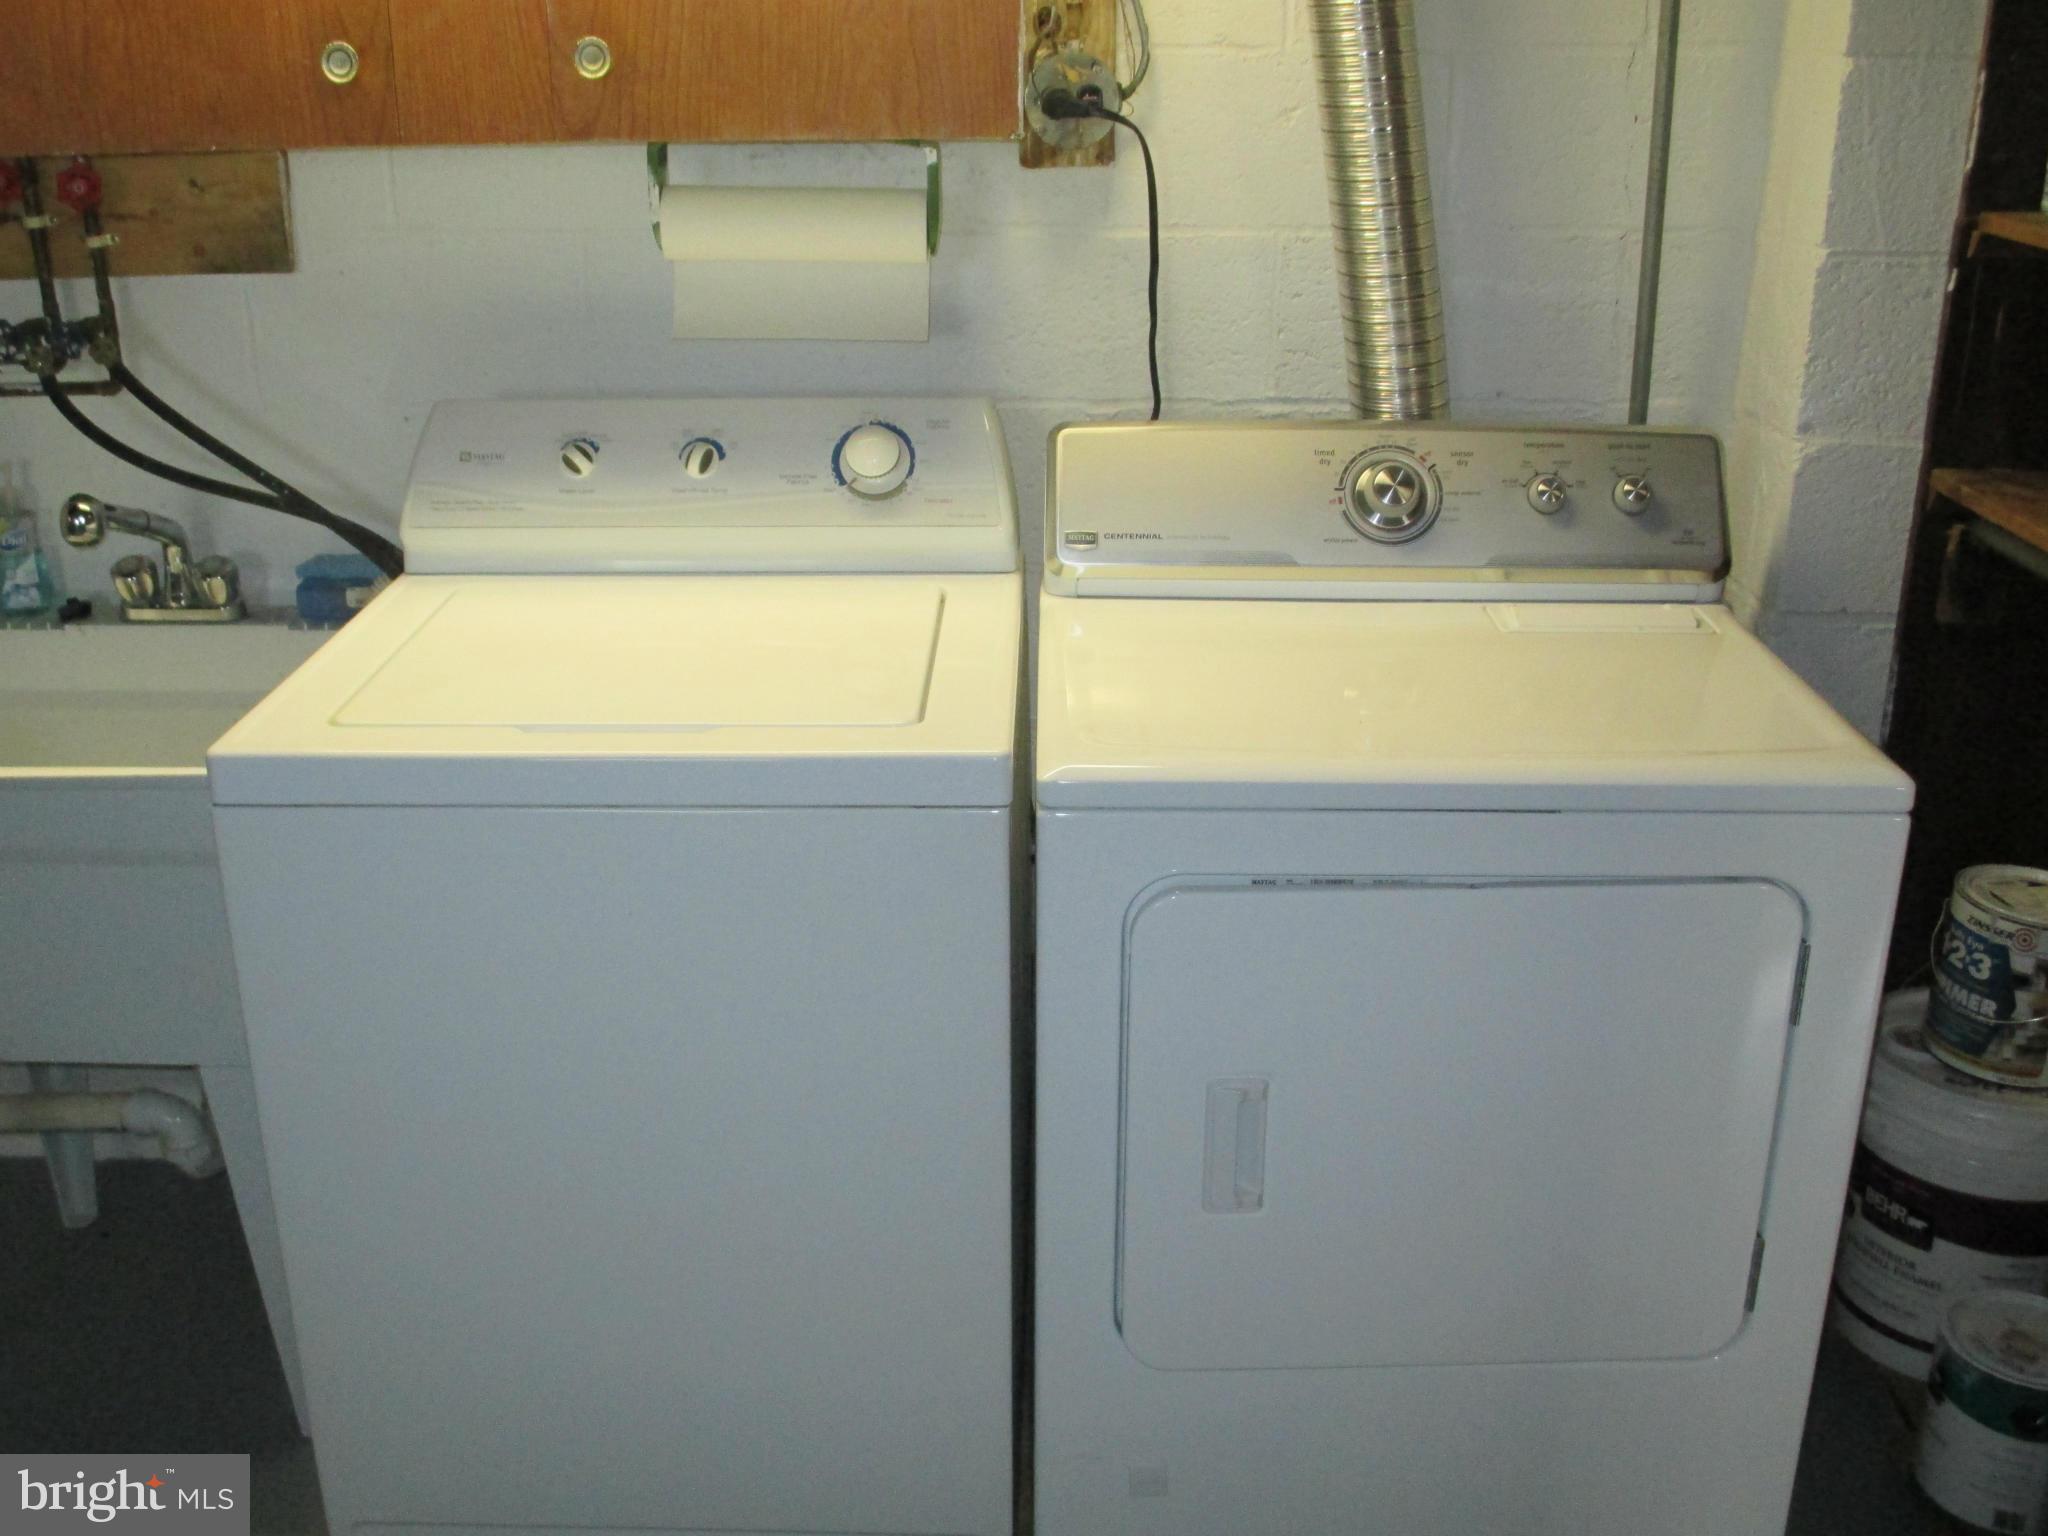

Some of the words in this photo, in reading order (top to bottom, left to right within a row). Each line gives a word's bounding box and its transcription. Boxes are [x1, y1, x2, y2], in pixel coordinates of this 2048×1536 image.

[1314, 448, 1335, 456] timed
[1319, 458, 1331, 466] dry
[1456, 459, 1469, 467] dry
[1103, 532, 1163, 540] CENTENNIAL
[1865, 1184, 1907, 1223] BEHR
